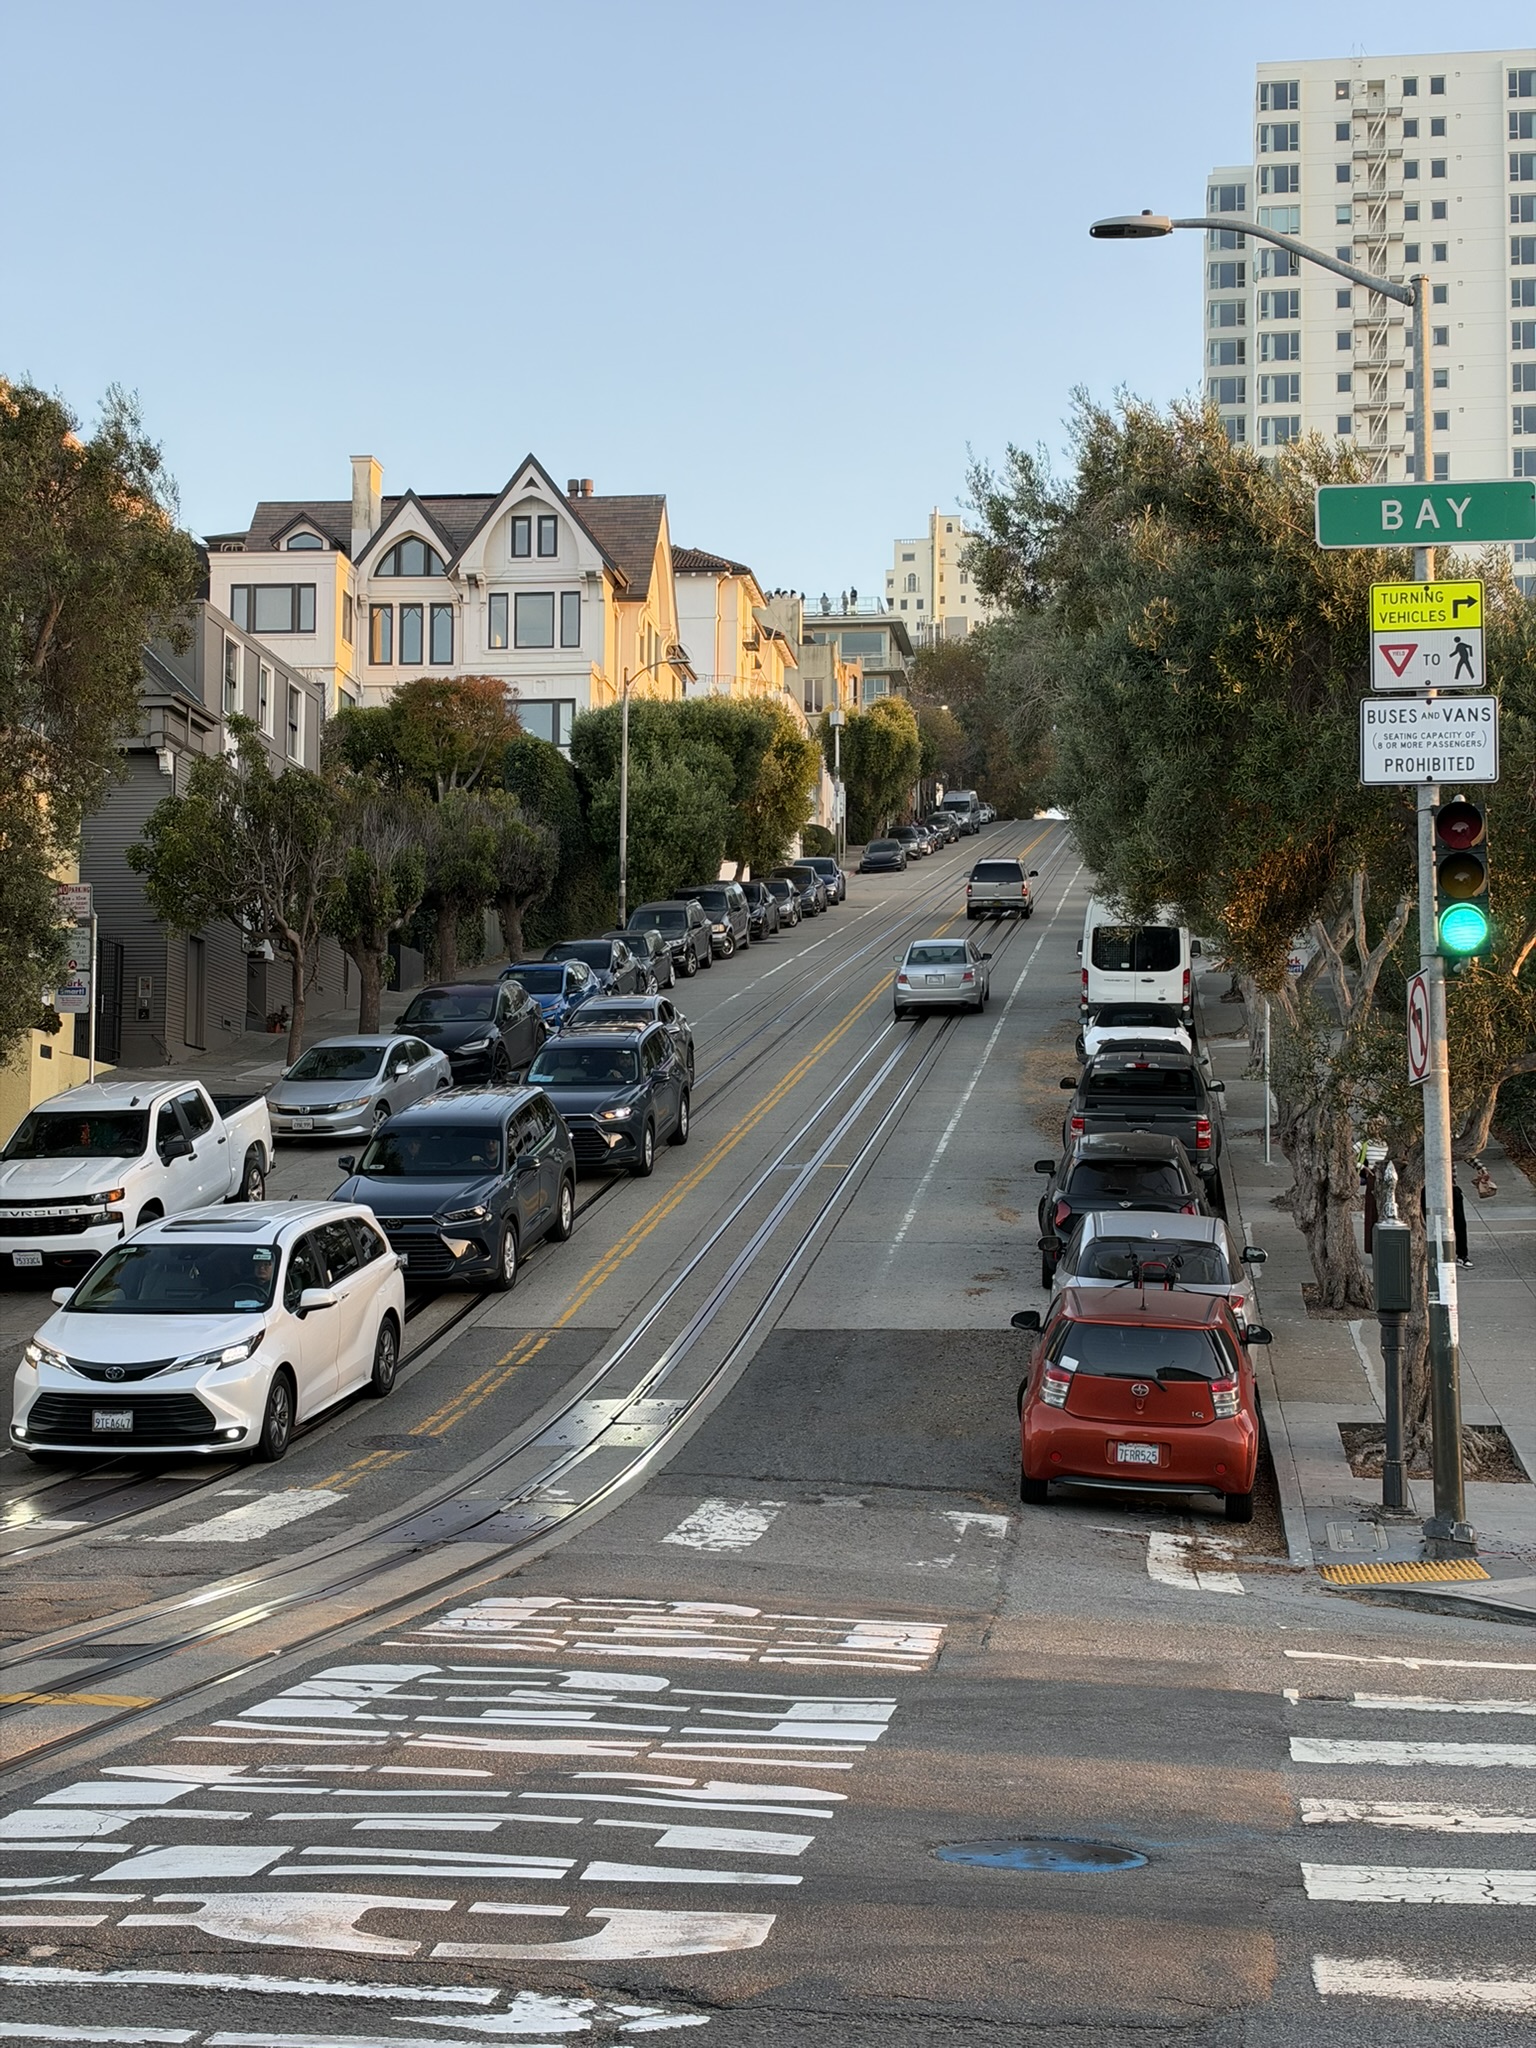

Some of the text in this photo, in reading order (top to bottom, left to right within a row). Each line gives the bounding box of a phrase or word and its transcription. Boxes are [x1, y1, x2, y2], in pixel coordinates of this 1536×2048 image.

[1381, 497, 1472, 531] BAY
[1381, 591, 1444, 605] TURNING
[1379, 610, 1446, 624] VEHICLES
[1423, 653, 1441, 666] TO
[1367, 707, 1491, 724] BUSES AND VANS
[1383, 731, 1476, 740] SEATING CAPACITY OF
[1400, 741, 1423, 749] MORE
[1426, 740, 1482, 749] PASSENGERS
[1384, 756, 1475, 773] PROHIBITED
[58, 884, 68, 895] NO
[67, 979, 84, 987] ark
[1119, 1448, 1158, 1462] 7FRR525
